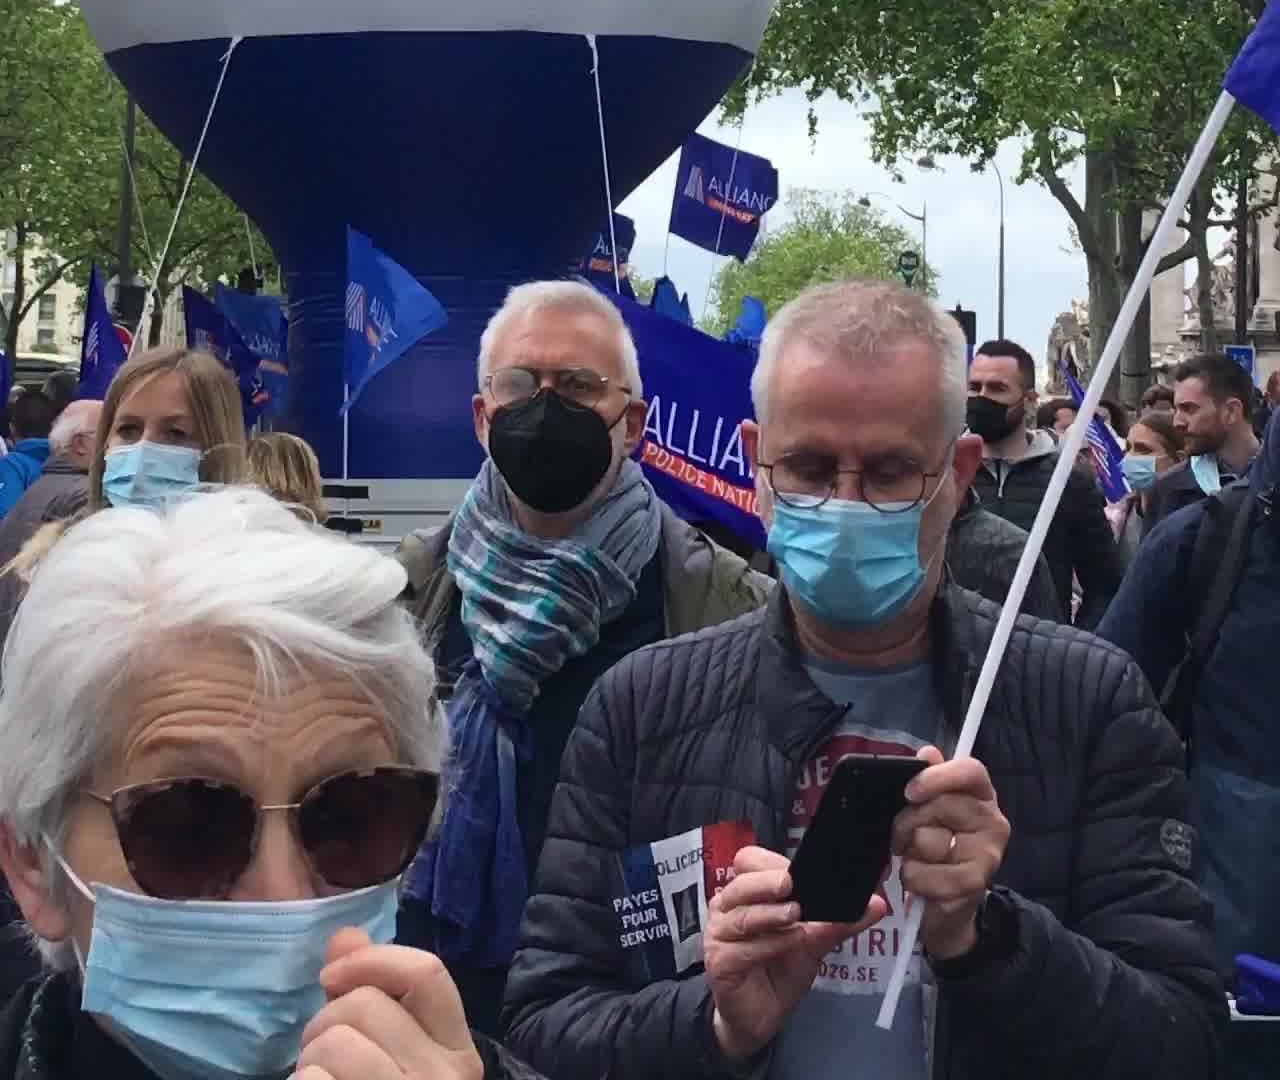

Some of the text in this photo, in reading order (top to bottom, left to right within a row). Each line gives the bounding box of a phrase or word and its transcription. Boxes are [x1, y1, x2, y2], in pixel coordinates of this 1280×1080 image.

[642, 395, 753, 479] ALLIA
[646, 441, 707, 490] POLICE
[613, 889, 659, 913] PAYES
[621, 908, 659, 930] POUR
[620, 923, 670, 949] SERVIR
